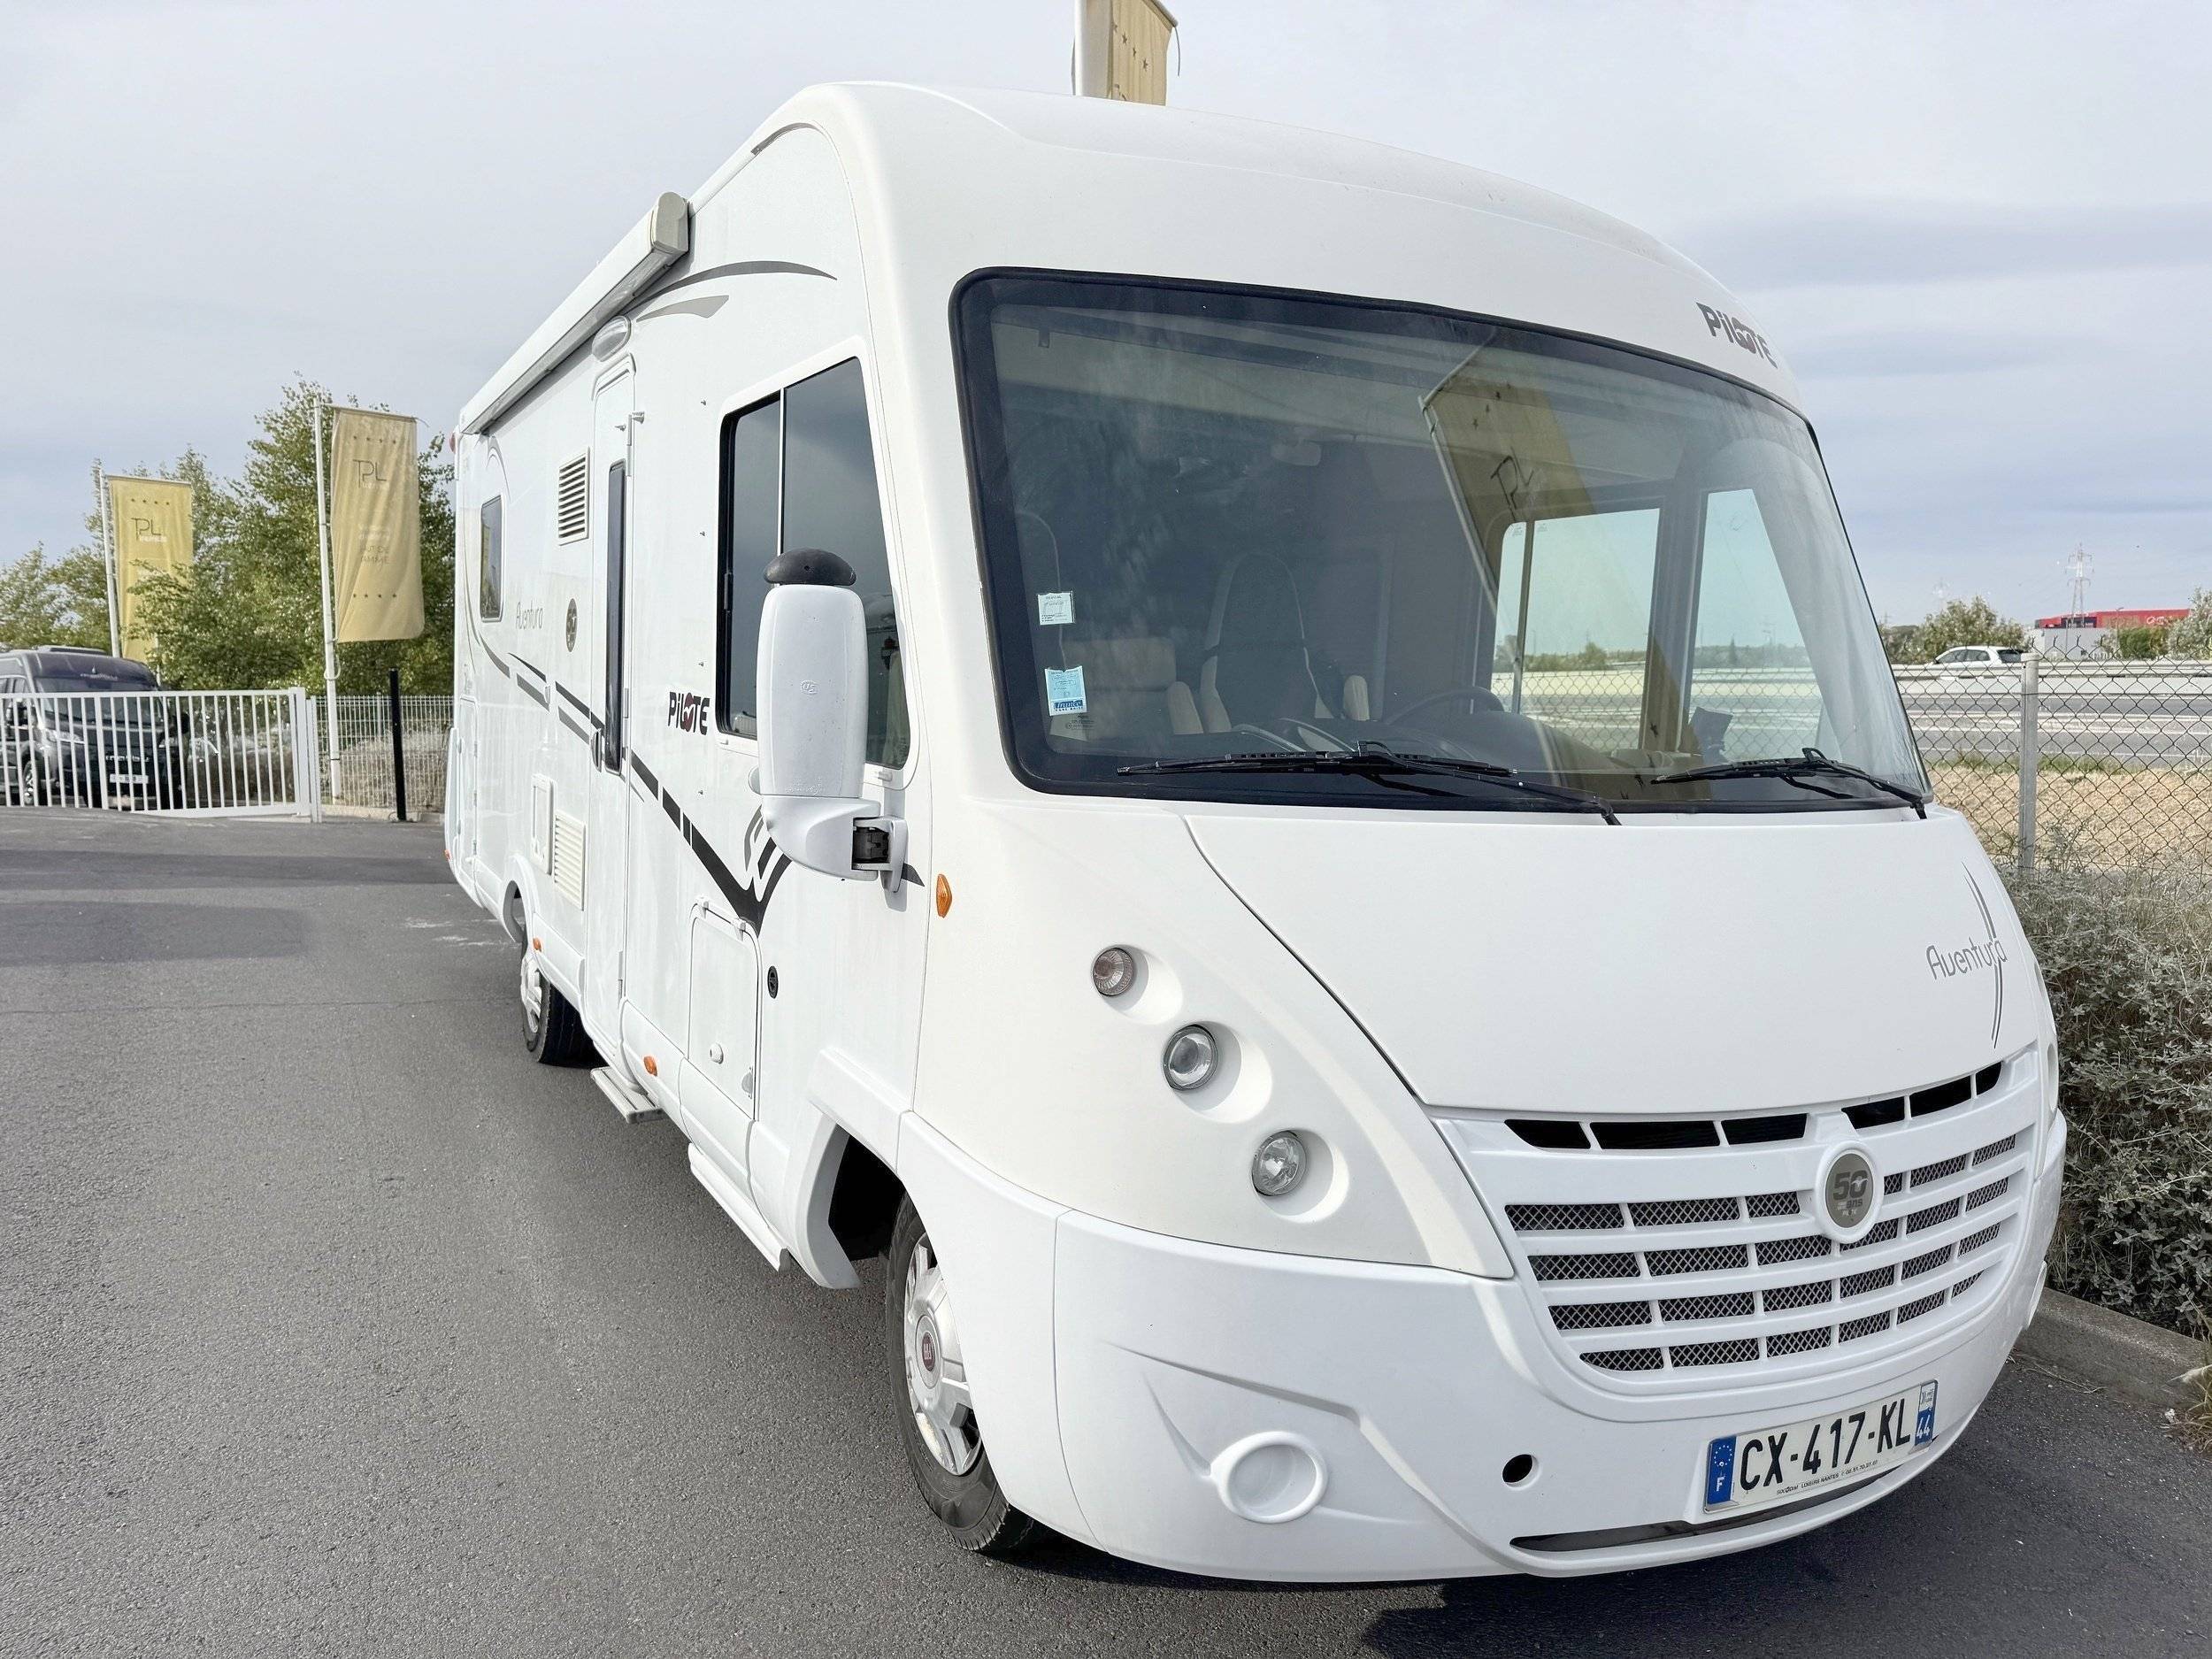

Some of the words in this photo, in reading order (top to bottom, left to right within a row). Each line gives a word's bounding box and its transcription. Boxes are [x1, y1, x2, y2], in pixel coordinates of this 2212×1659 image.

[352, 458, 388, 488] TPL
[131, 517, 162, 541] TPL
[515, 599, 544, 630] Aventura
[1925, 936, 2008, 981] Aventura
[1832, 1170, 1869, 1201] 50
[1716, 1475, 1726, 1493] F
[1739, 1398, 1912, 1492] CX-417-KL
[1916, 1413, 1931, 1440] 44
[1820, 1472, 1839, 1483] NANTES
